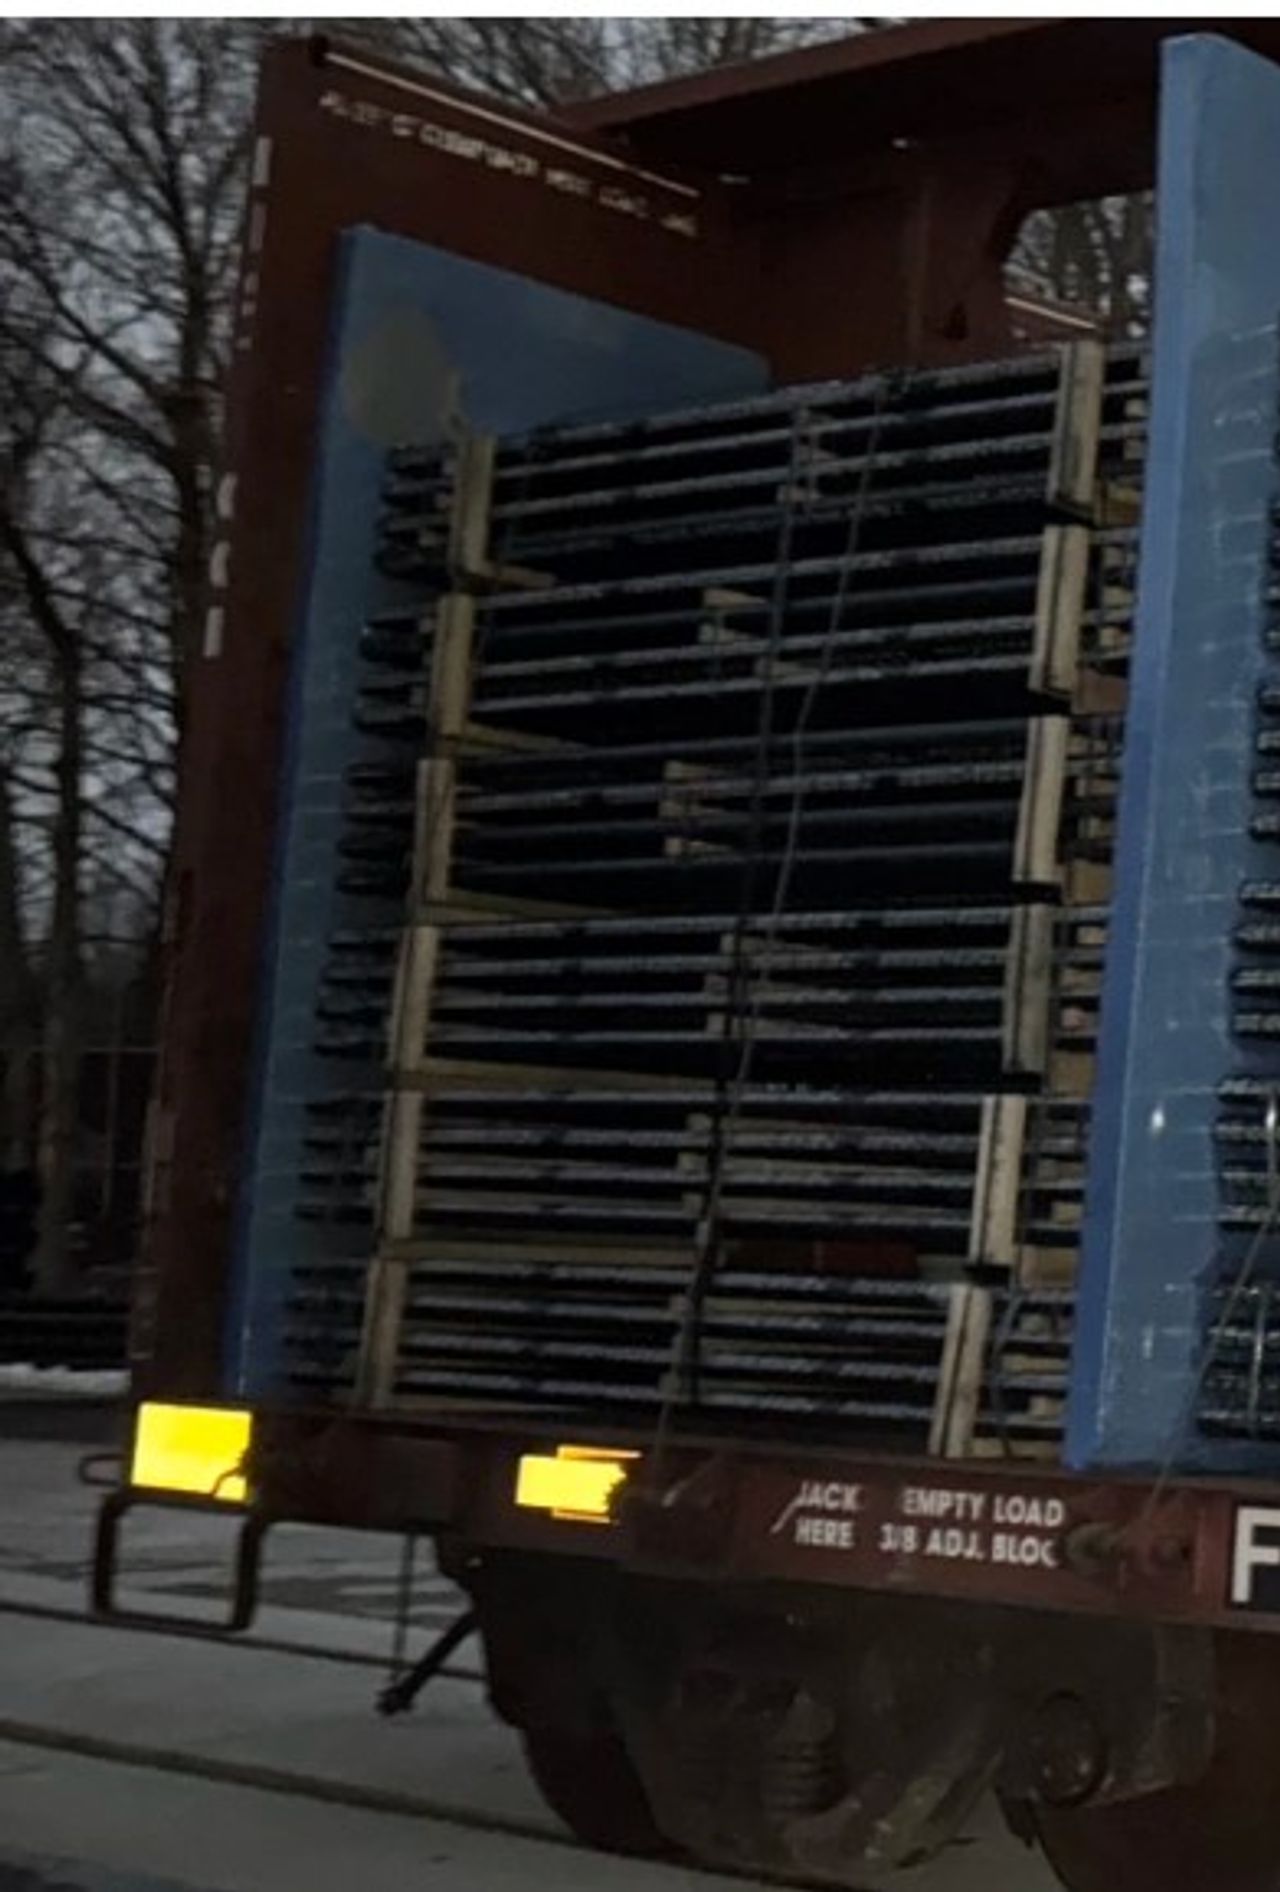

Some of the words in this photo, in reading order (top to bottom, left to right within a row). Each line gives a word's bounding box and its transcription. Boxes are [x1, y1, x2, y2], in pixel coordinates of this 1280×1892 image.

[797, 1482, 859, 1512] JACK
[902, 1487, 986, 1521] EMPTY
[993, 1495, 1065, 1527] LOAD
[795, 1517, 854, 1548] HERE
[878, 1522, 918, 1553] 3/8
[925, 1526, 984, 1560] ADJ.
[991, 1533, 1058, 1567] BLOC
